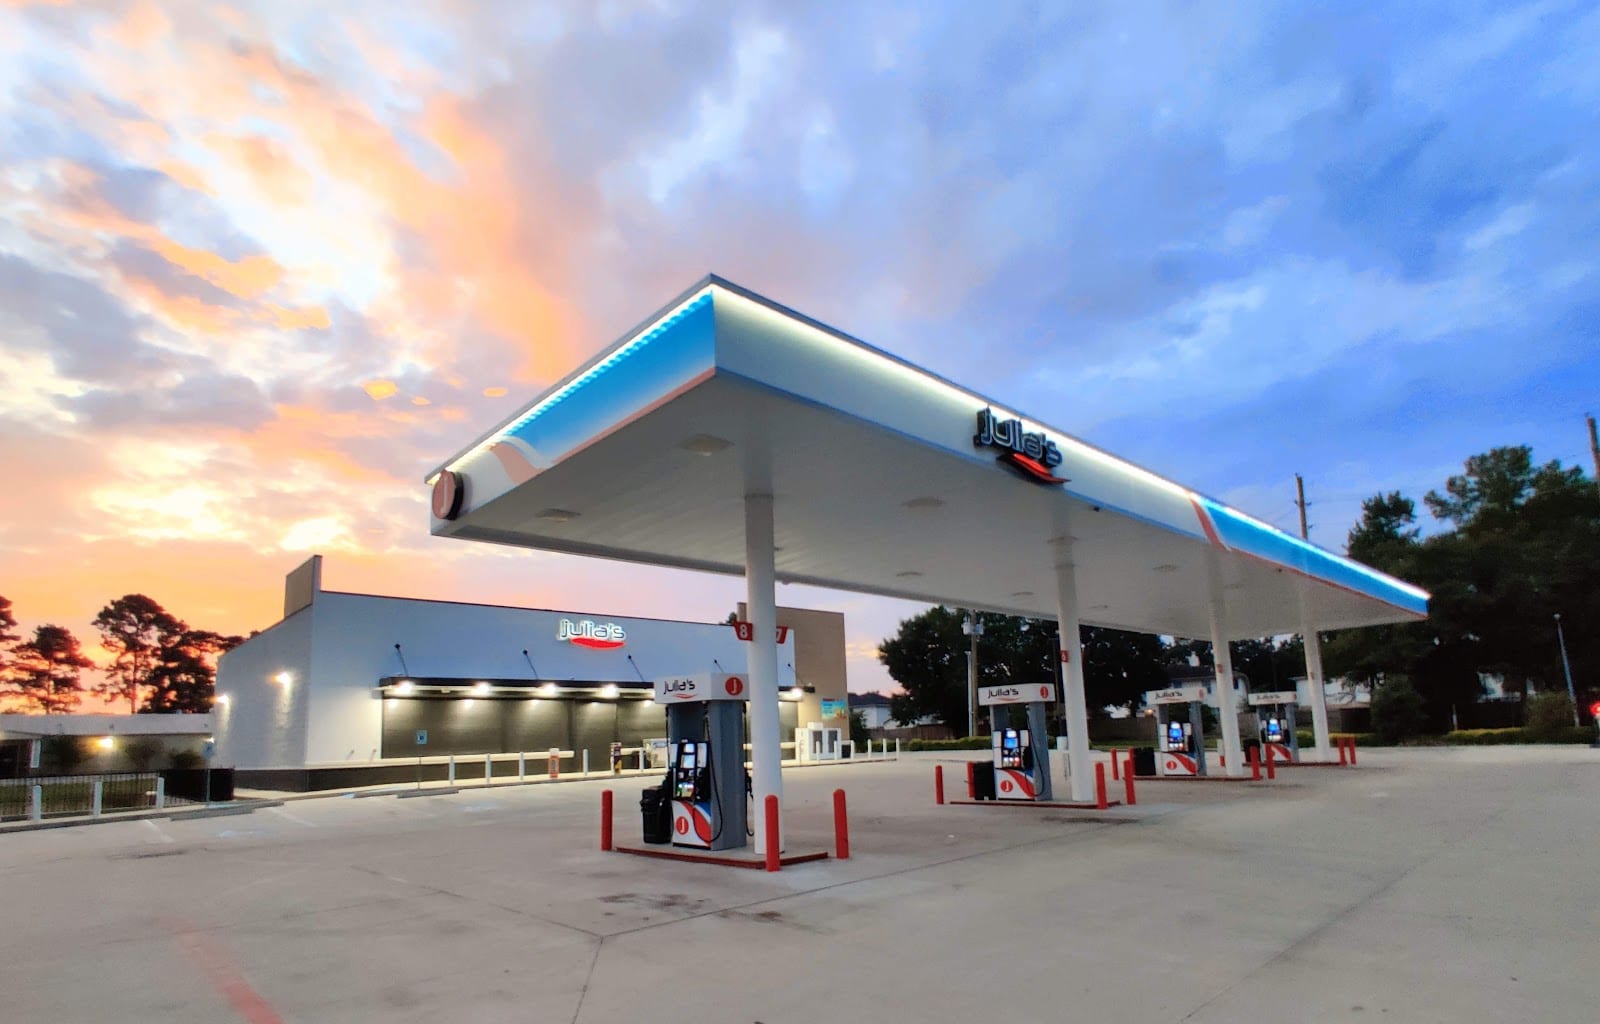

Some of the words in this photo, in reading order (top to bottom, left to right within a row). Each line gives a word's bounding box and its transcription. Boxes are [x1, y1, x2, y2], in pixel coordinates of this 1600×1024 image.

[973, 406, 1062, 468] julia's
[558, 618, 626, 641] julia's
[740, 624, 748, 639] 8
[663, 678, 696, 694] julia's
[987, 687, 1019, 699] julia's
